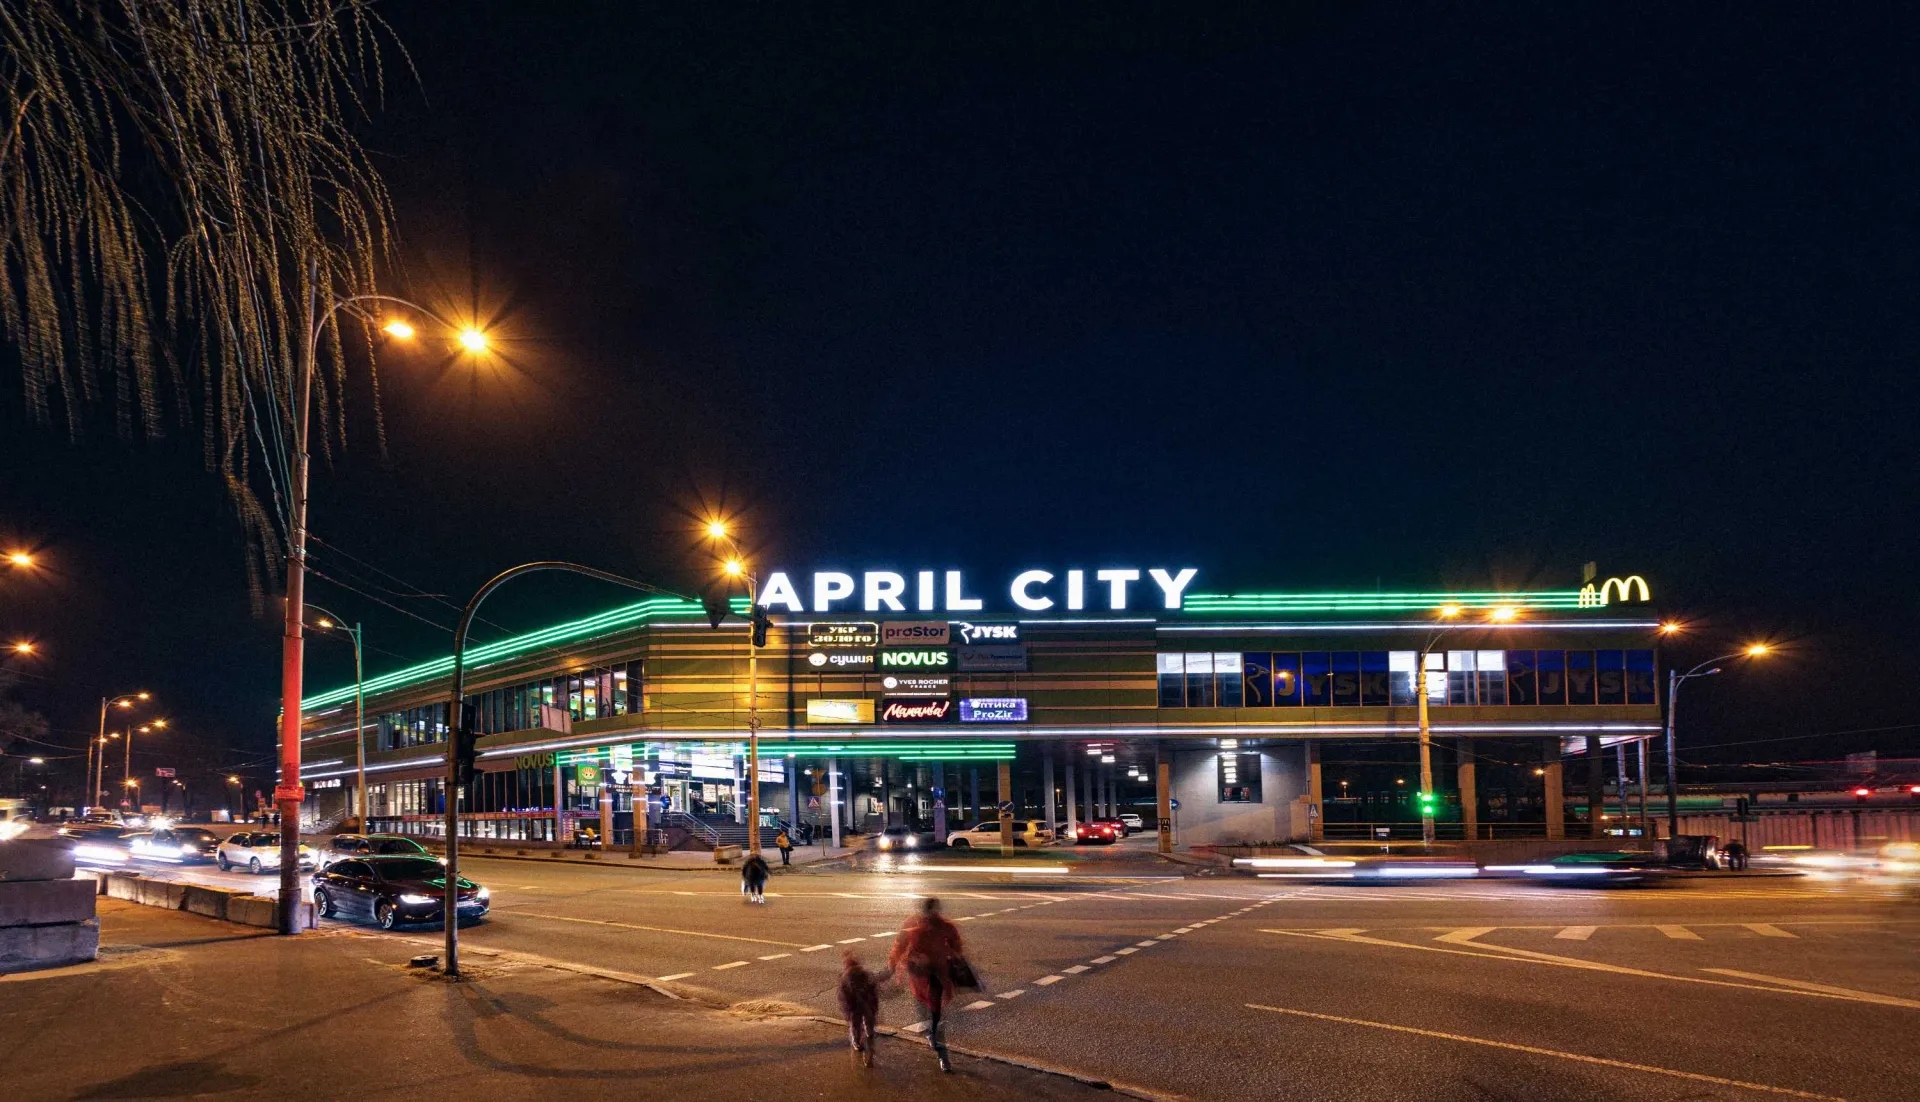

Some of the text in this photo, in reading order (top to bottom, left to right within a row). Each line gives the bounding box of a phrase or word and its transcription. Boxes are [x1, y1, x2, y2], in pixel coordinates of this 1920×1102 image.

[757, 569, 1198, 611] APRIL CITY
[829, 626, 857, 634] УКР
[886, 626, 946, 639] proStor
[971, 626, 1017, 638] JYSK
[829, 655, 874, 666] сушия
[882, 652, 948, 666] NOVUS
[1277, 672, 1388, 696] JYSK
[1541, 671, 1651, 694] JYSK
[974, 710, 1013, 718] ProZir
[514, 752, 555, 770] NOVUS
